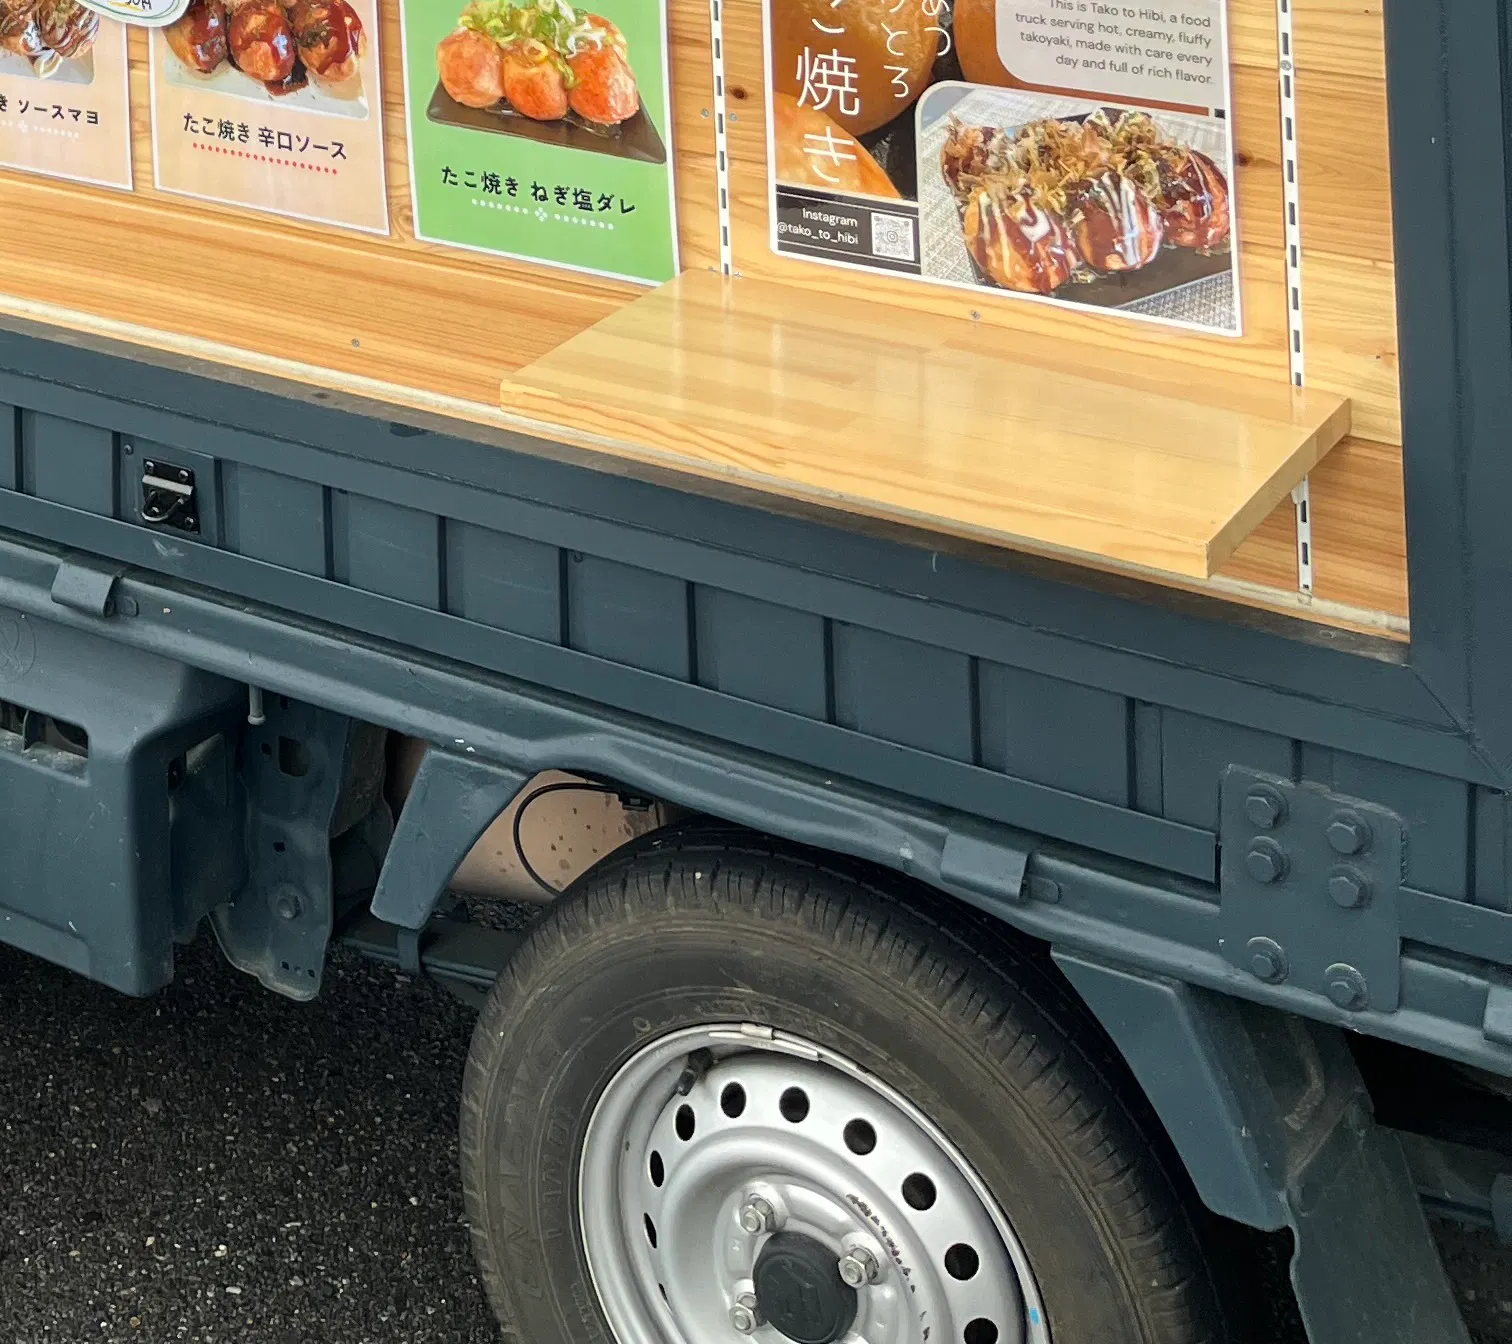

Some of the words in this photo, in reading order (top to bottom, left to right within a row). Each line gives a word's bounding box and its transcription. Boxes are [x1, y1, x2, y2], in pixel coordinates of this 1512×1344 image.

[1077, 0, 1086, 12] is
[1090, 2, 1118, 16] Tako
[1123, 7, 1135, 18] to
[1139, 9, 1166, 23] Hibi,
[1170, 14, 1177, 24] a
[1180, 13, 1211, 28] food
[1016, 12, 1047, 26] truck
[1050, 19, 1094, 34] serving
[1098, 22, 1122, 37] hot,
[1126, 27, 1175, 43] creamy,
[1178, 31, 1211, 49] fluffy
[1020, 31, 1072, 48] takoyaki,
[1076, 38, 1111, 52] made
[1115, 43, 1141, 55] with
[1145, 49, 1173, 60] care
[1177, 53, 1212, 67] every
[1056, 54, 1078, 69] day
[1082, 58, 1106, 70] and
[1109, 60, 1128, 73] full
[1131, 64, 1144, 75] of
[1148, 66, 1172, 79] rich
[1175, 69, 1214, 84] flavor.
[18, 99, 99, 124] ソースマヨ
[183, 112, 250, 143] たこ焼き
[258, 126, 347, 160] 辛口ソース
[442, 166, 518, 197] たこ焼き
[531, 181, 635, 214] ねぎ塩ダレ
[802, 208, 858, 227] Instagram
[777, 222, 858, 245] @tako_to_hibi
